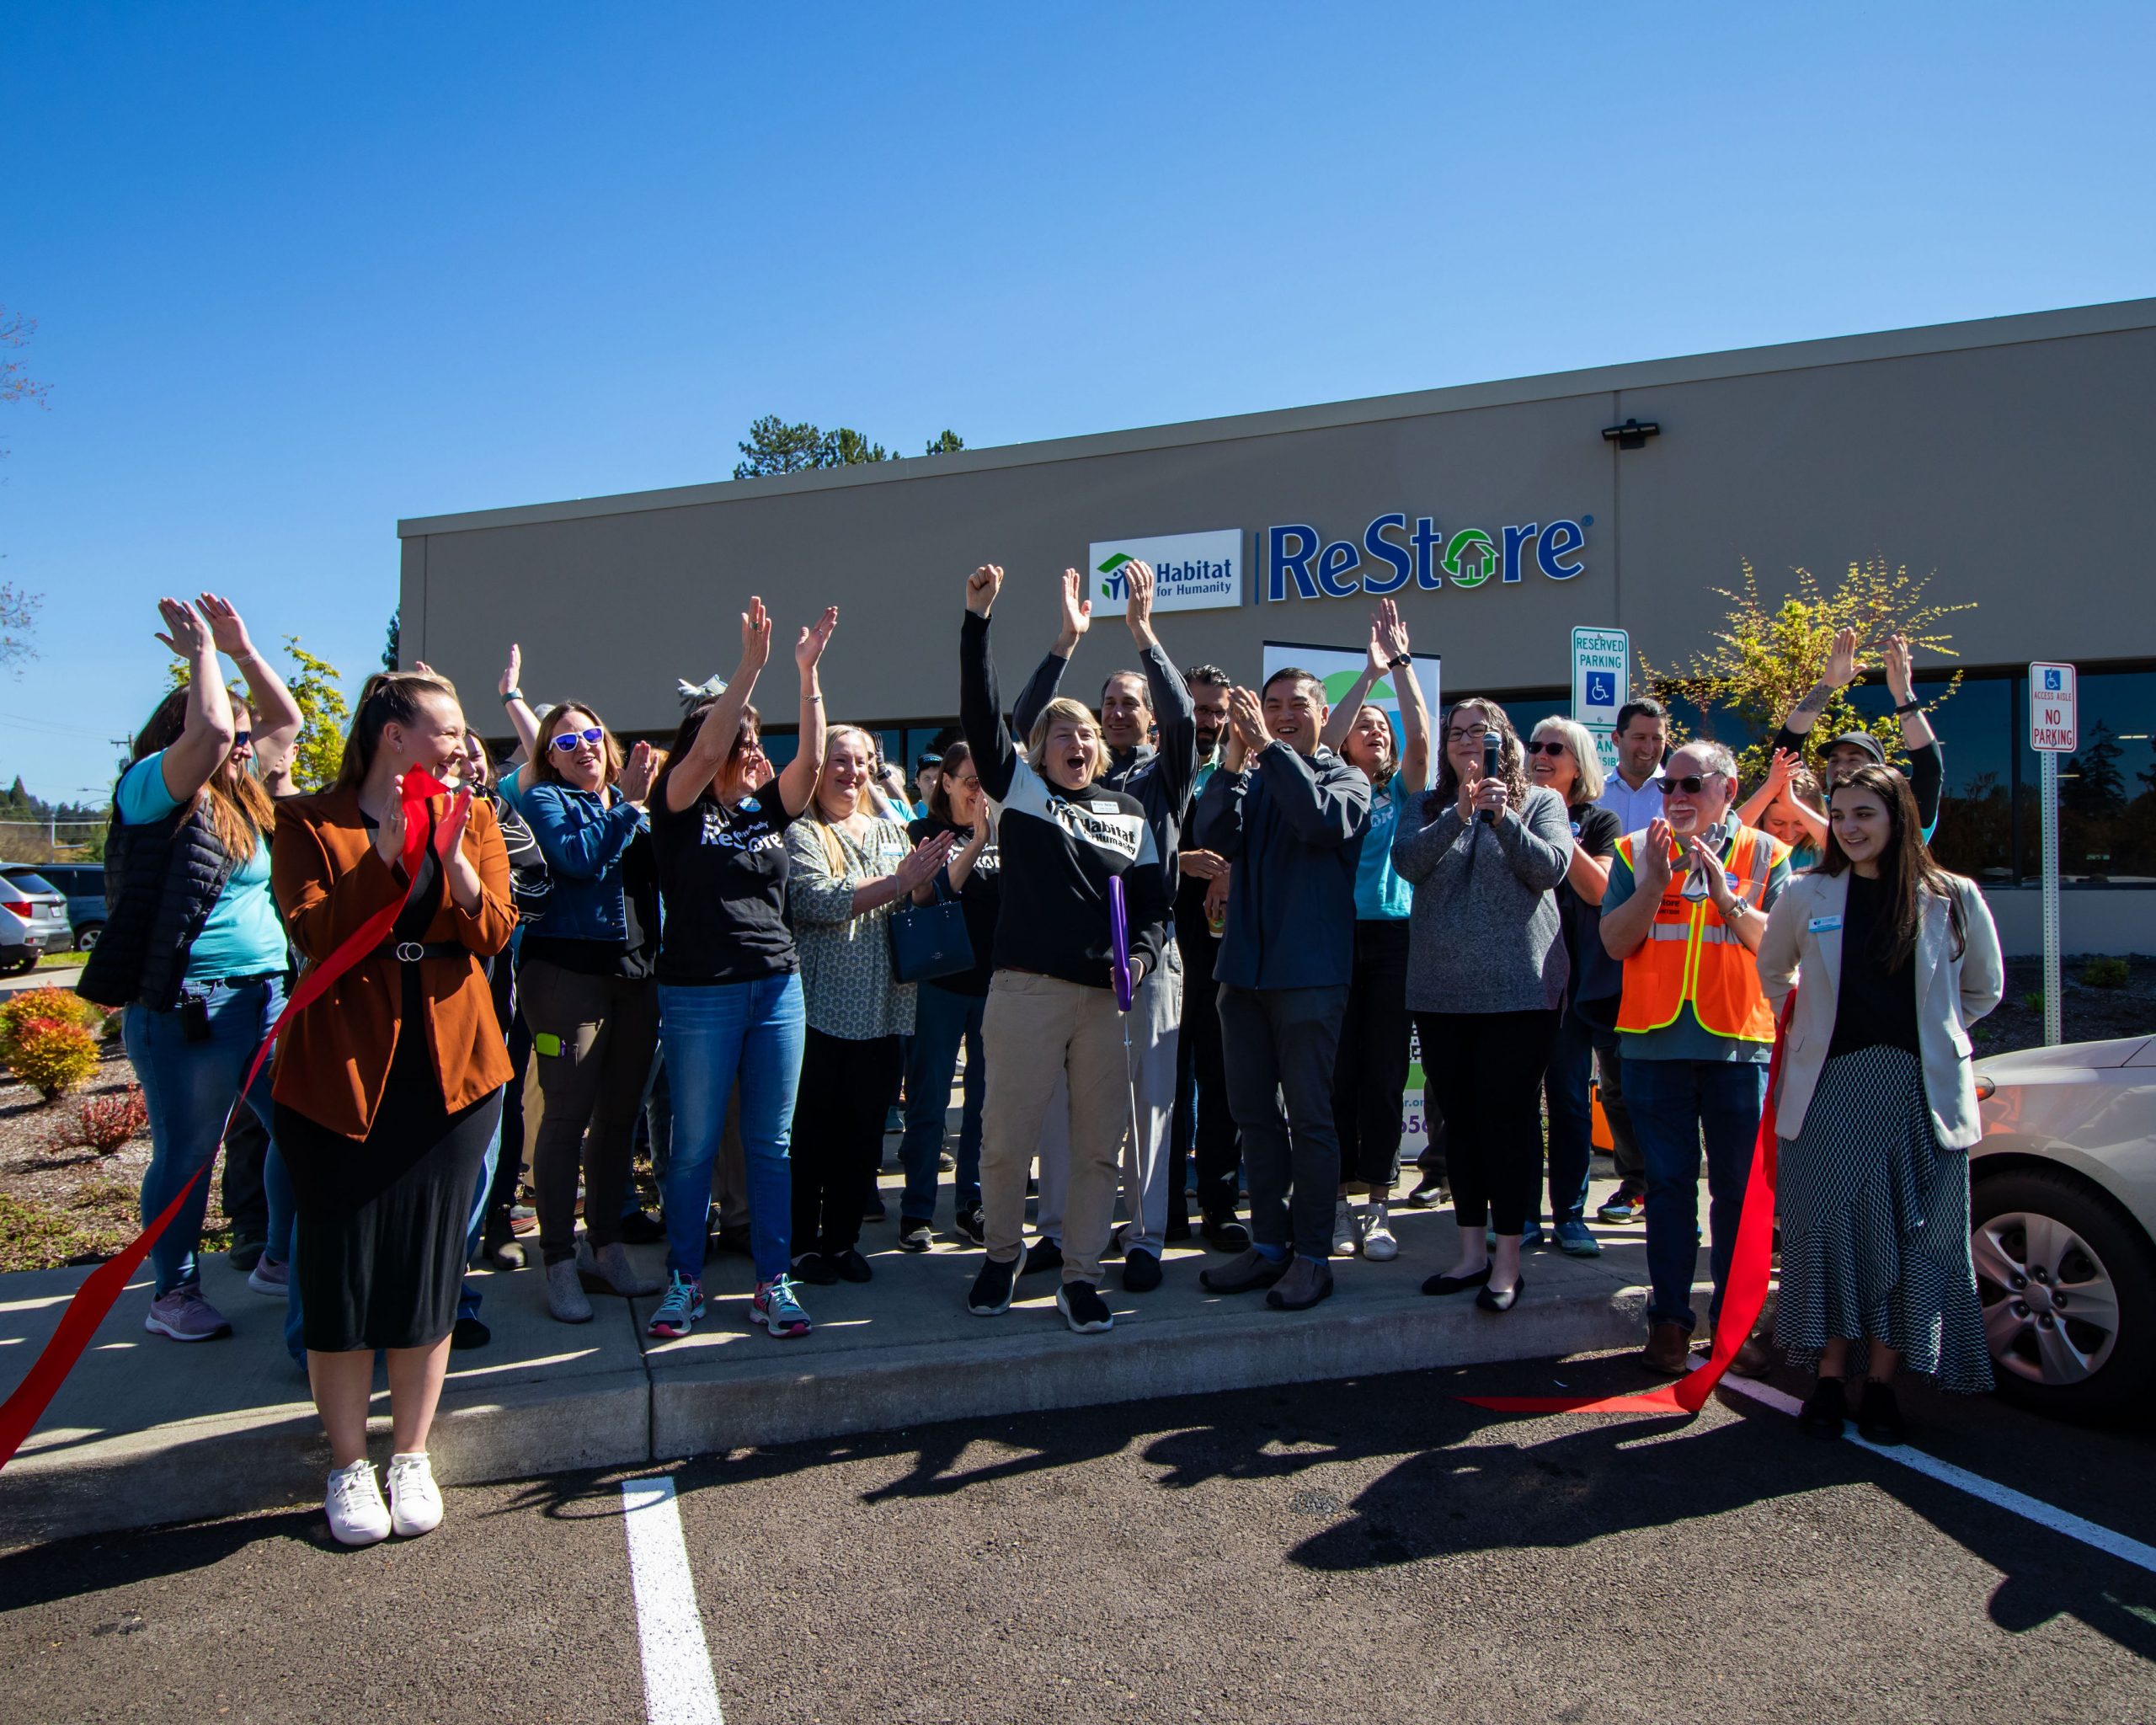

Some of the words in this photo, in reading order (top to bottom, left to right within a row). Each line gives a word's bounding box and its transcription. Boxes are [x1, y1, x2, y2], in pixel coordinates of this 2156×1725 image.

[1156, 558, 1231, 583] Habitat
[1156, 586, 1172, 596] for
[1177, 581, 1231, 594] Humanity
[1577, 638, 1624, 652] RESERVED
[1580, 654, 1621, 669] PARKING
[2034, 692, 2053, 700] ACCESS
[2057, 692, 2072, 701] AISLE
[2045, 709, 2061, 725] NO
[2034, 729, 2072, 745] PARKING
[1596, 740, 1613, 752] AN
[701, 824, 784, 852] ReSore
[1081, 818, 1135, 844] Habitat
